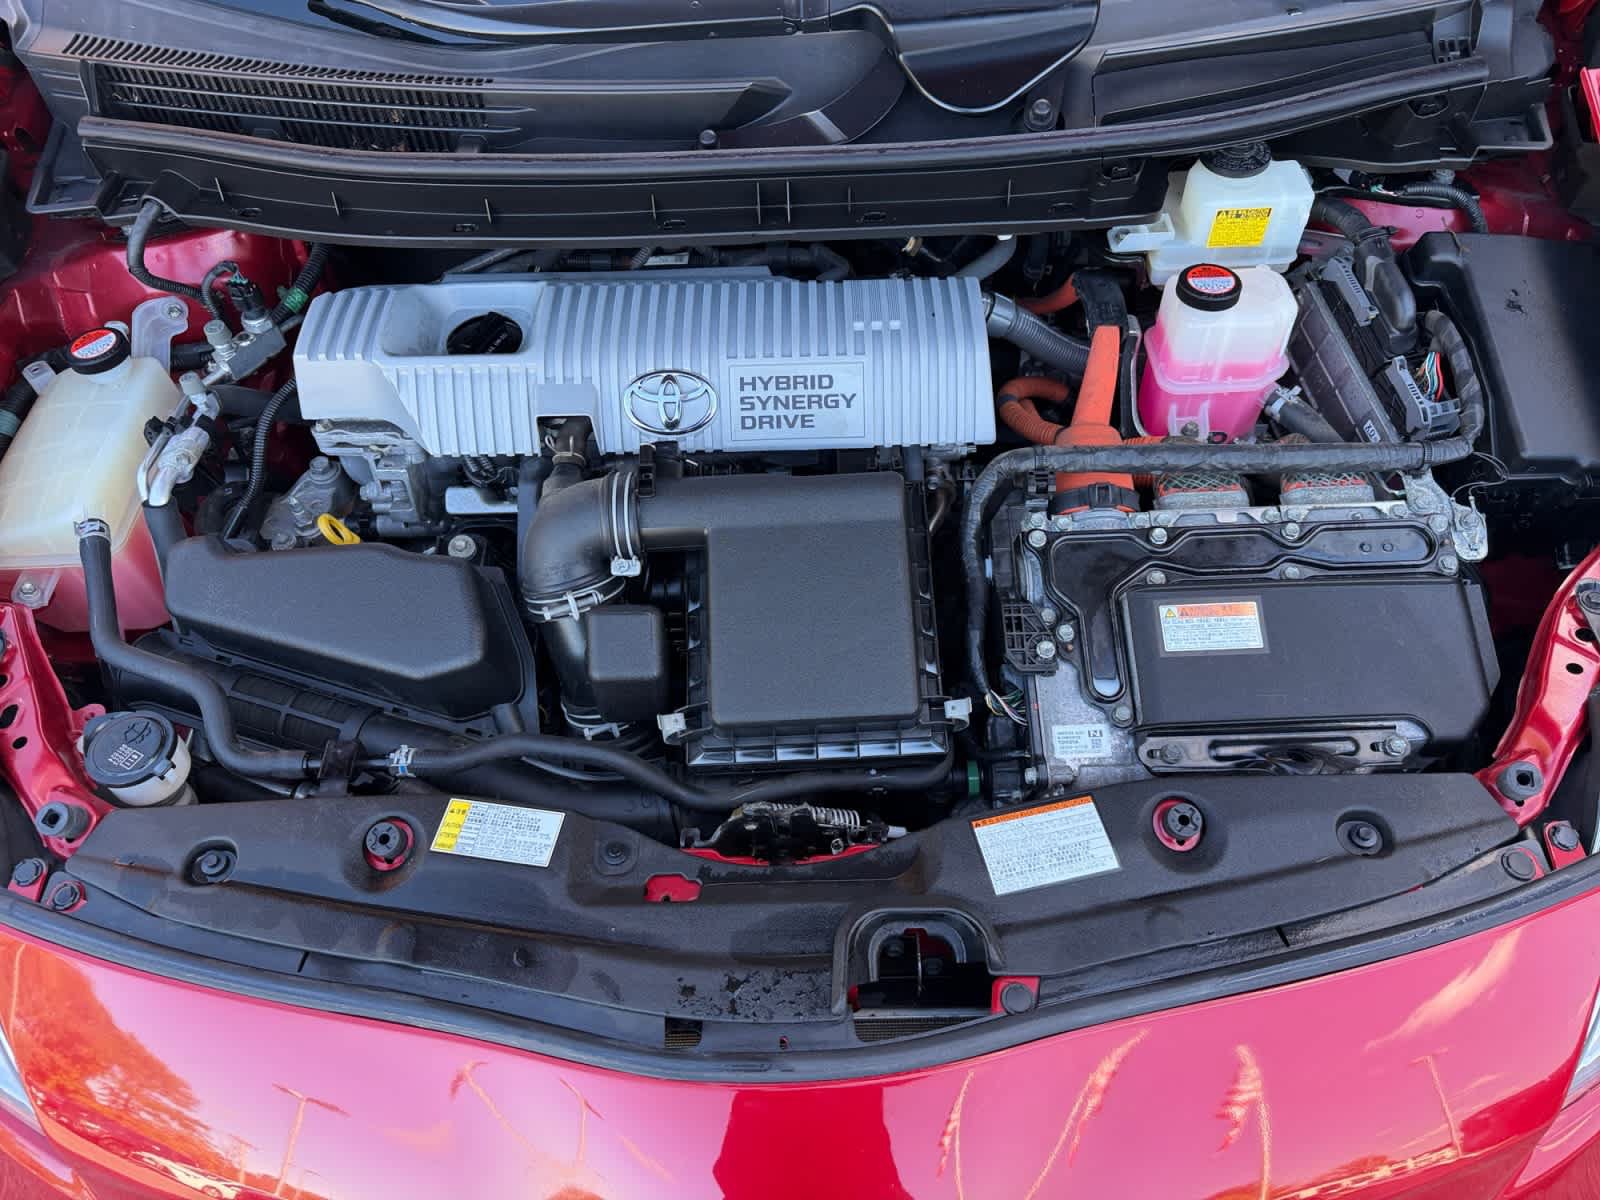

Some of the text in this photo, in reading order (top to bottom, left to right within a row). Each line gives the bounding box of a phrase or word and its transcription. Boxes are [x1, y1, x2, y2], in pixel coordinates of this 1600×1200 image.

[740, 374, 834, 391] HYBRID
[740, 393, 856, 411] SYNERGY
[741, 414, 815, 430] DRIVE
